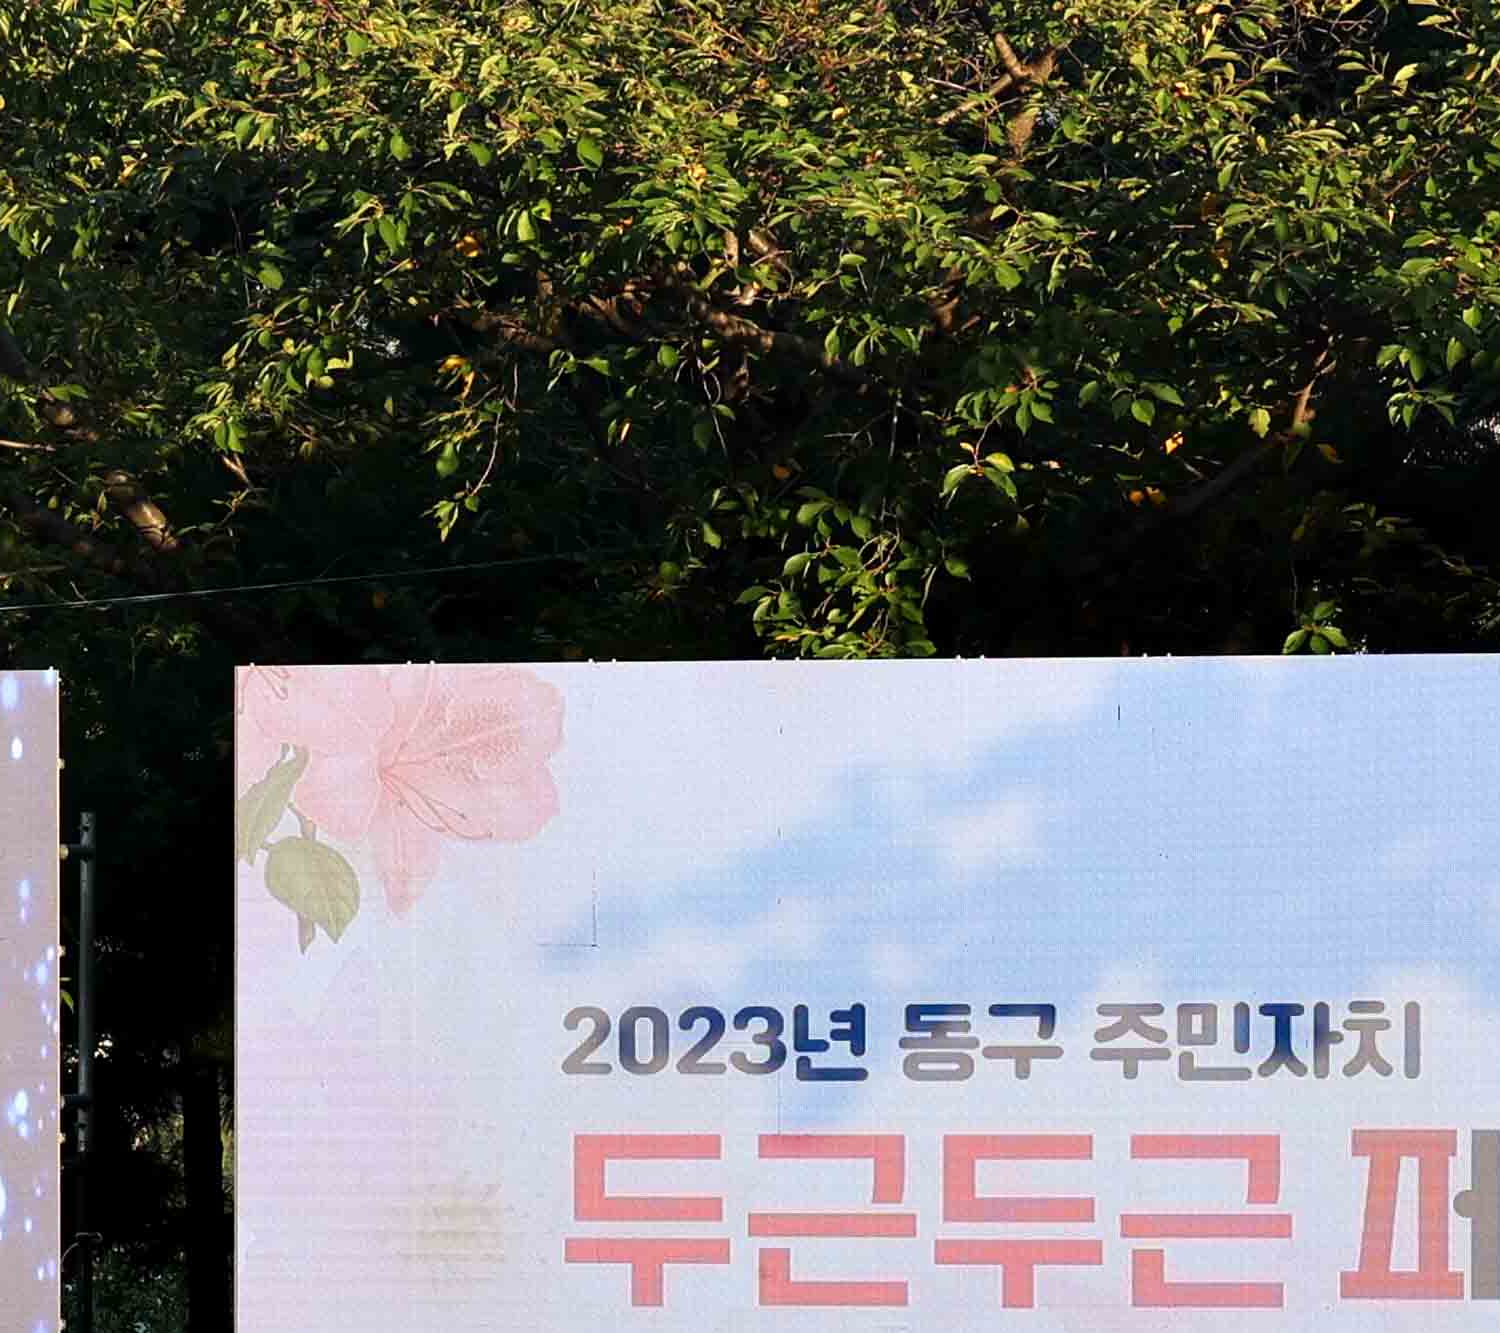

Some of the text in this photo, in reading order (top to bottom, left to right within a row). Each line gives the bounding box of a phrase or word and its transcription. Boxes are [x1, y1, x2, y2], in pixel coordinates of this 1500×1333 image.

[561, 1001, 1422, 1081] 2023년 동구 주민자치
[564, 1133, 1292, 1308] 두근두근
